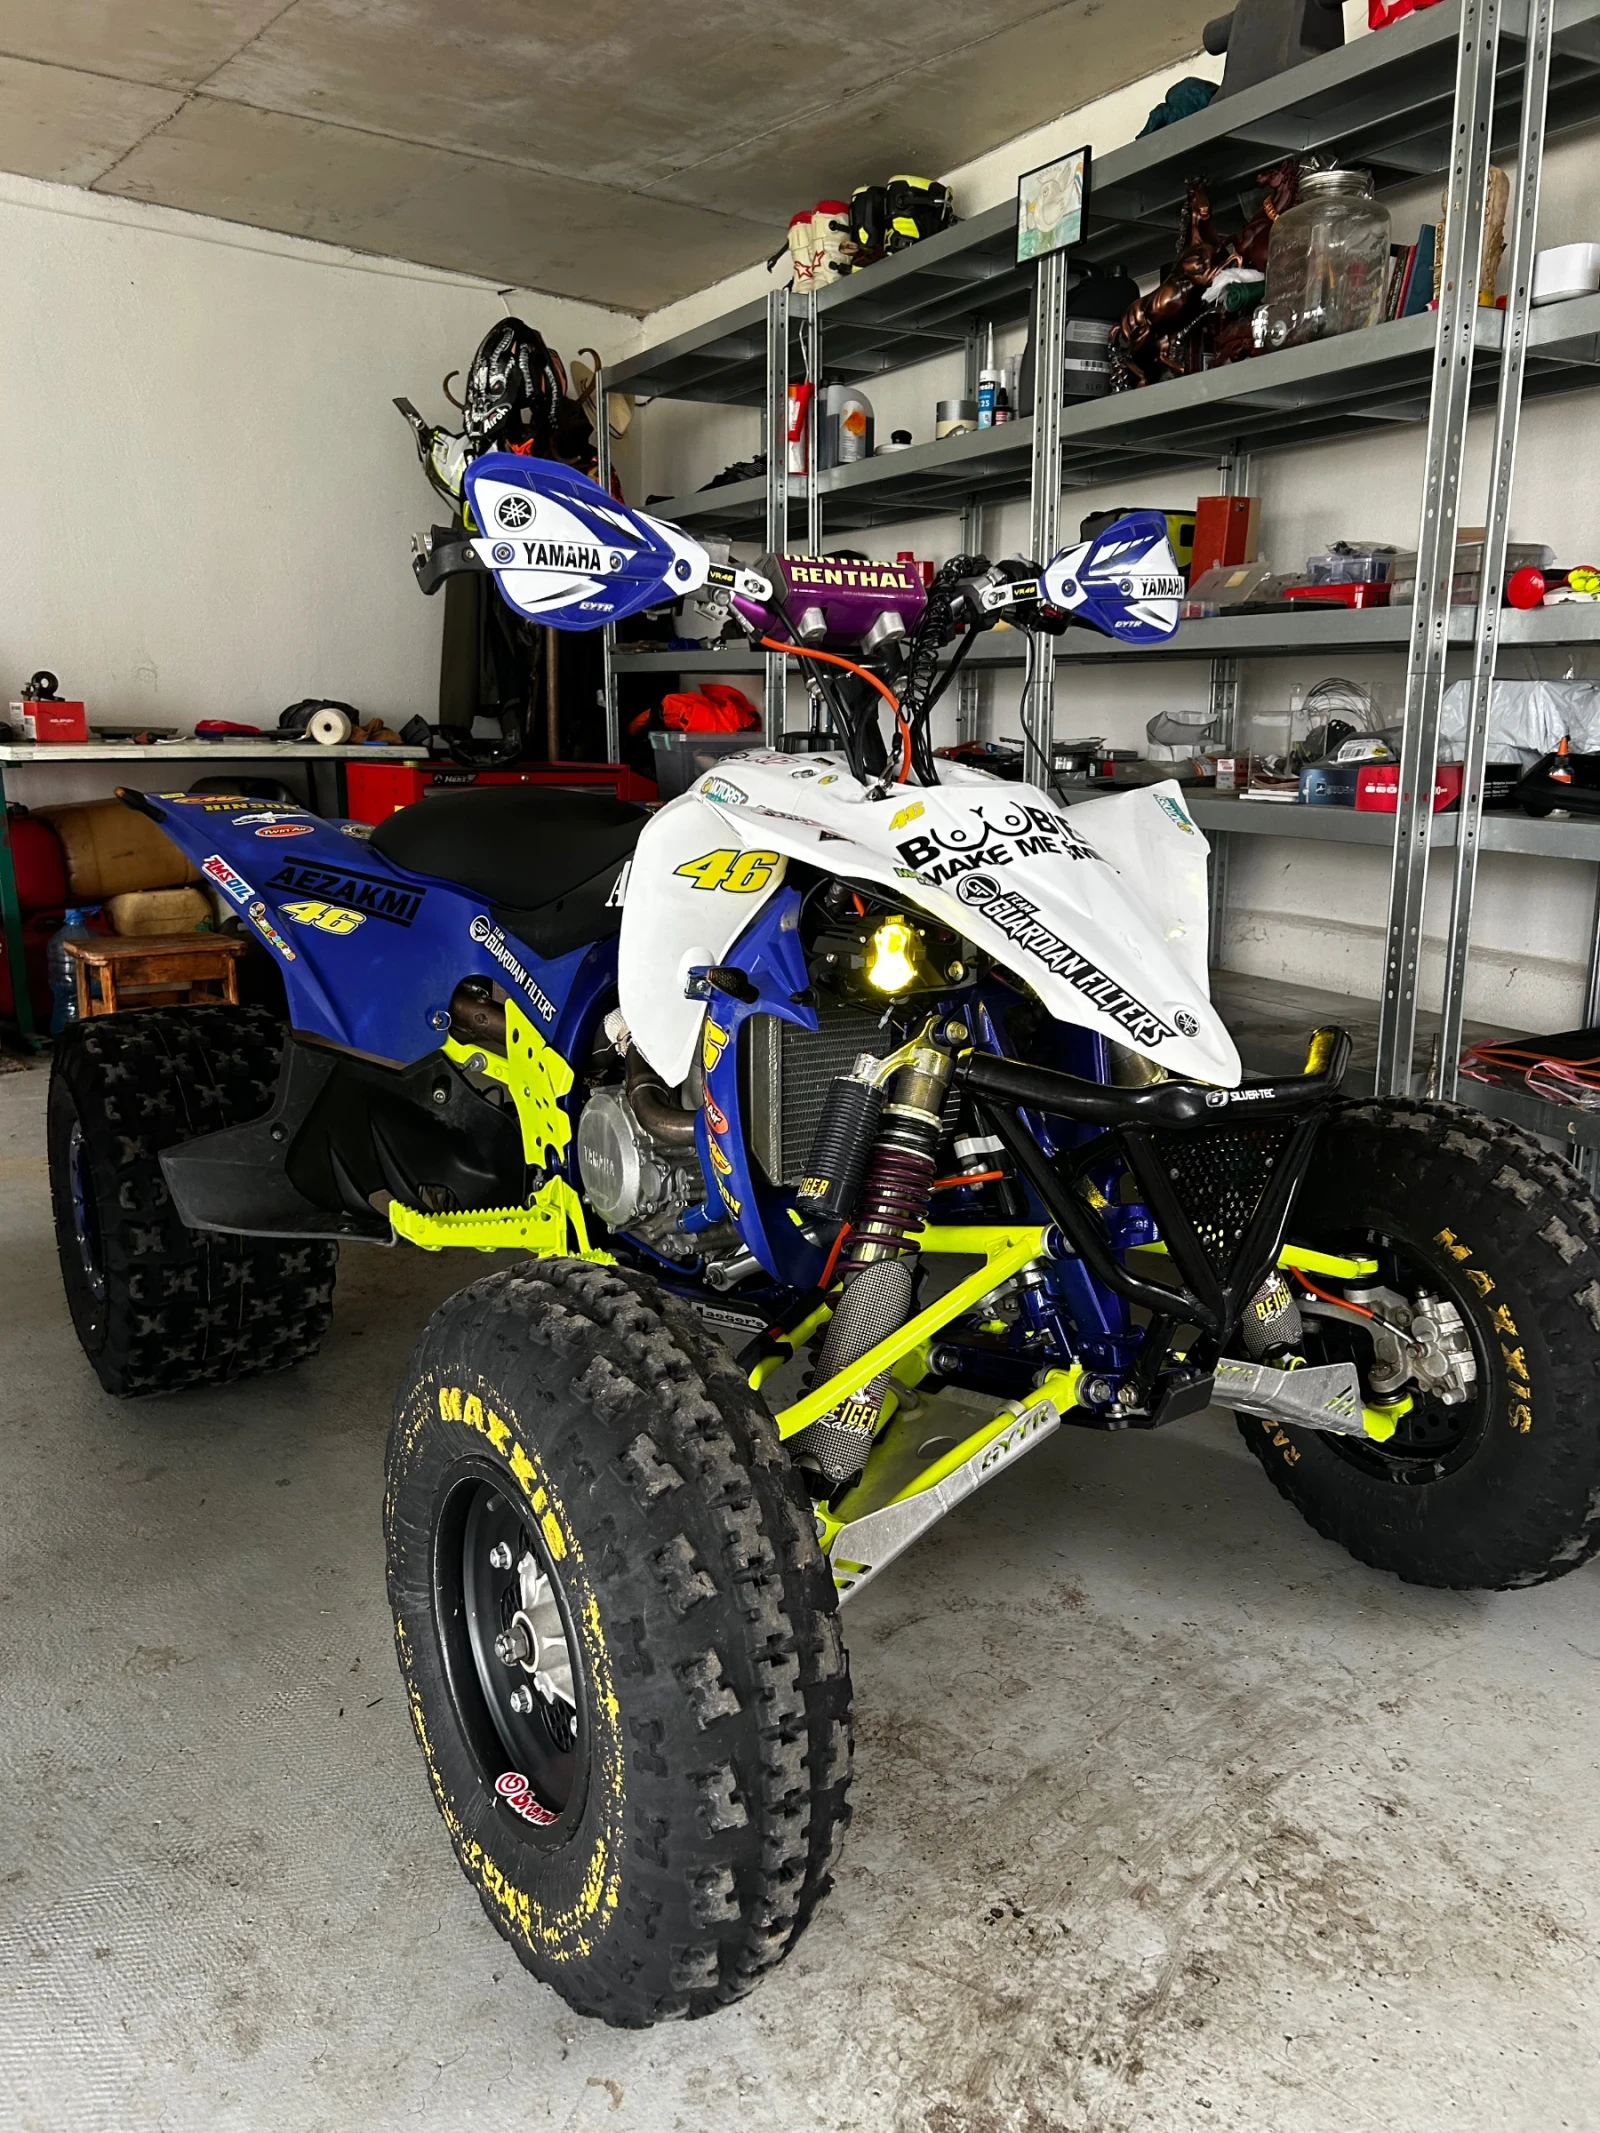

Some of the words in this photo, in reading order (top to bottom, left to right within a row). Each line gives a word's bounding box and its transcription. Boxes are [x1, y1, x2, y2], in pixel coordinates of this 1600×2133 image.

[522, 541, 601, 571] YAMAHA
[790, 566, 915, 589] RENTHAL
[888, 800, 925, 831] 46
[203, 856, 252, 900] AMSOIL
[674, 848, 780, 894] 46
[922, 844, 1014, 886] MAKE
[1014, 835, 1062, 857] ME
[270, 866, 423, 921] AEZAKMI
[1006, 892, 1037, 914] TEAM
[278, 900, 367, 935] 46
[484, 933, 528, 985] GUARDIAN
[524, 976, 556, 1022] FILTERS
[982, 898, 1089, 981] GUARDIAN
[1077, 970, 1172, 1045] FILTERS
[1432, 1227, 1532, 1434] MAXXIS
[1217, 1363, 1254, 1381] YTR
[981, 1405, 1049, 1472] GYTR
